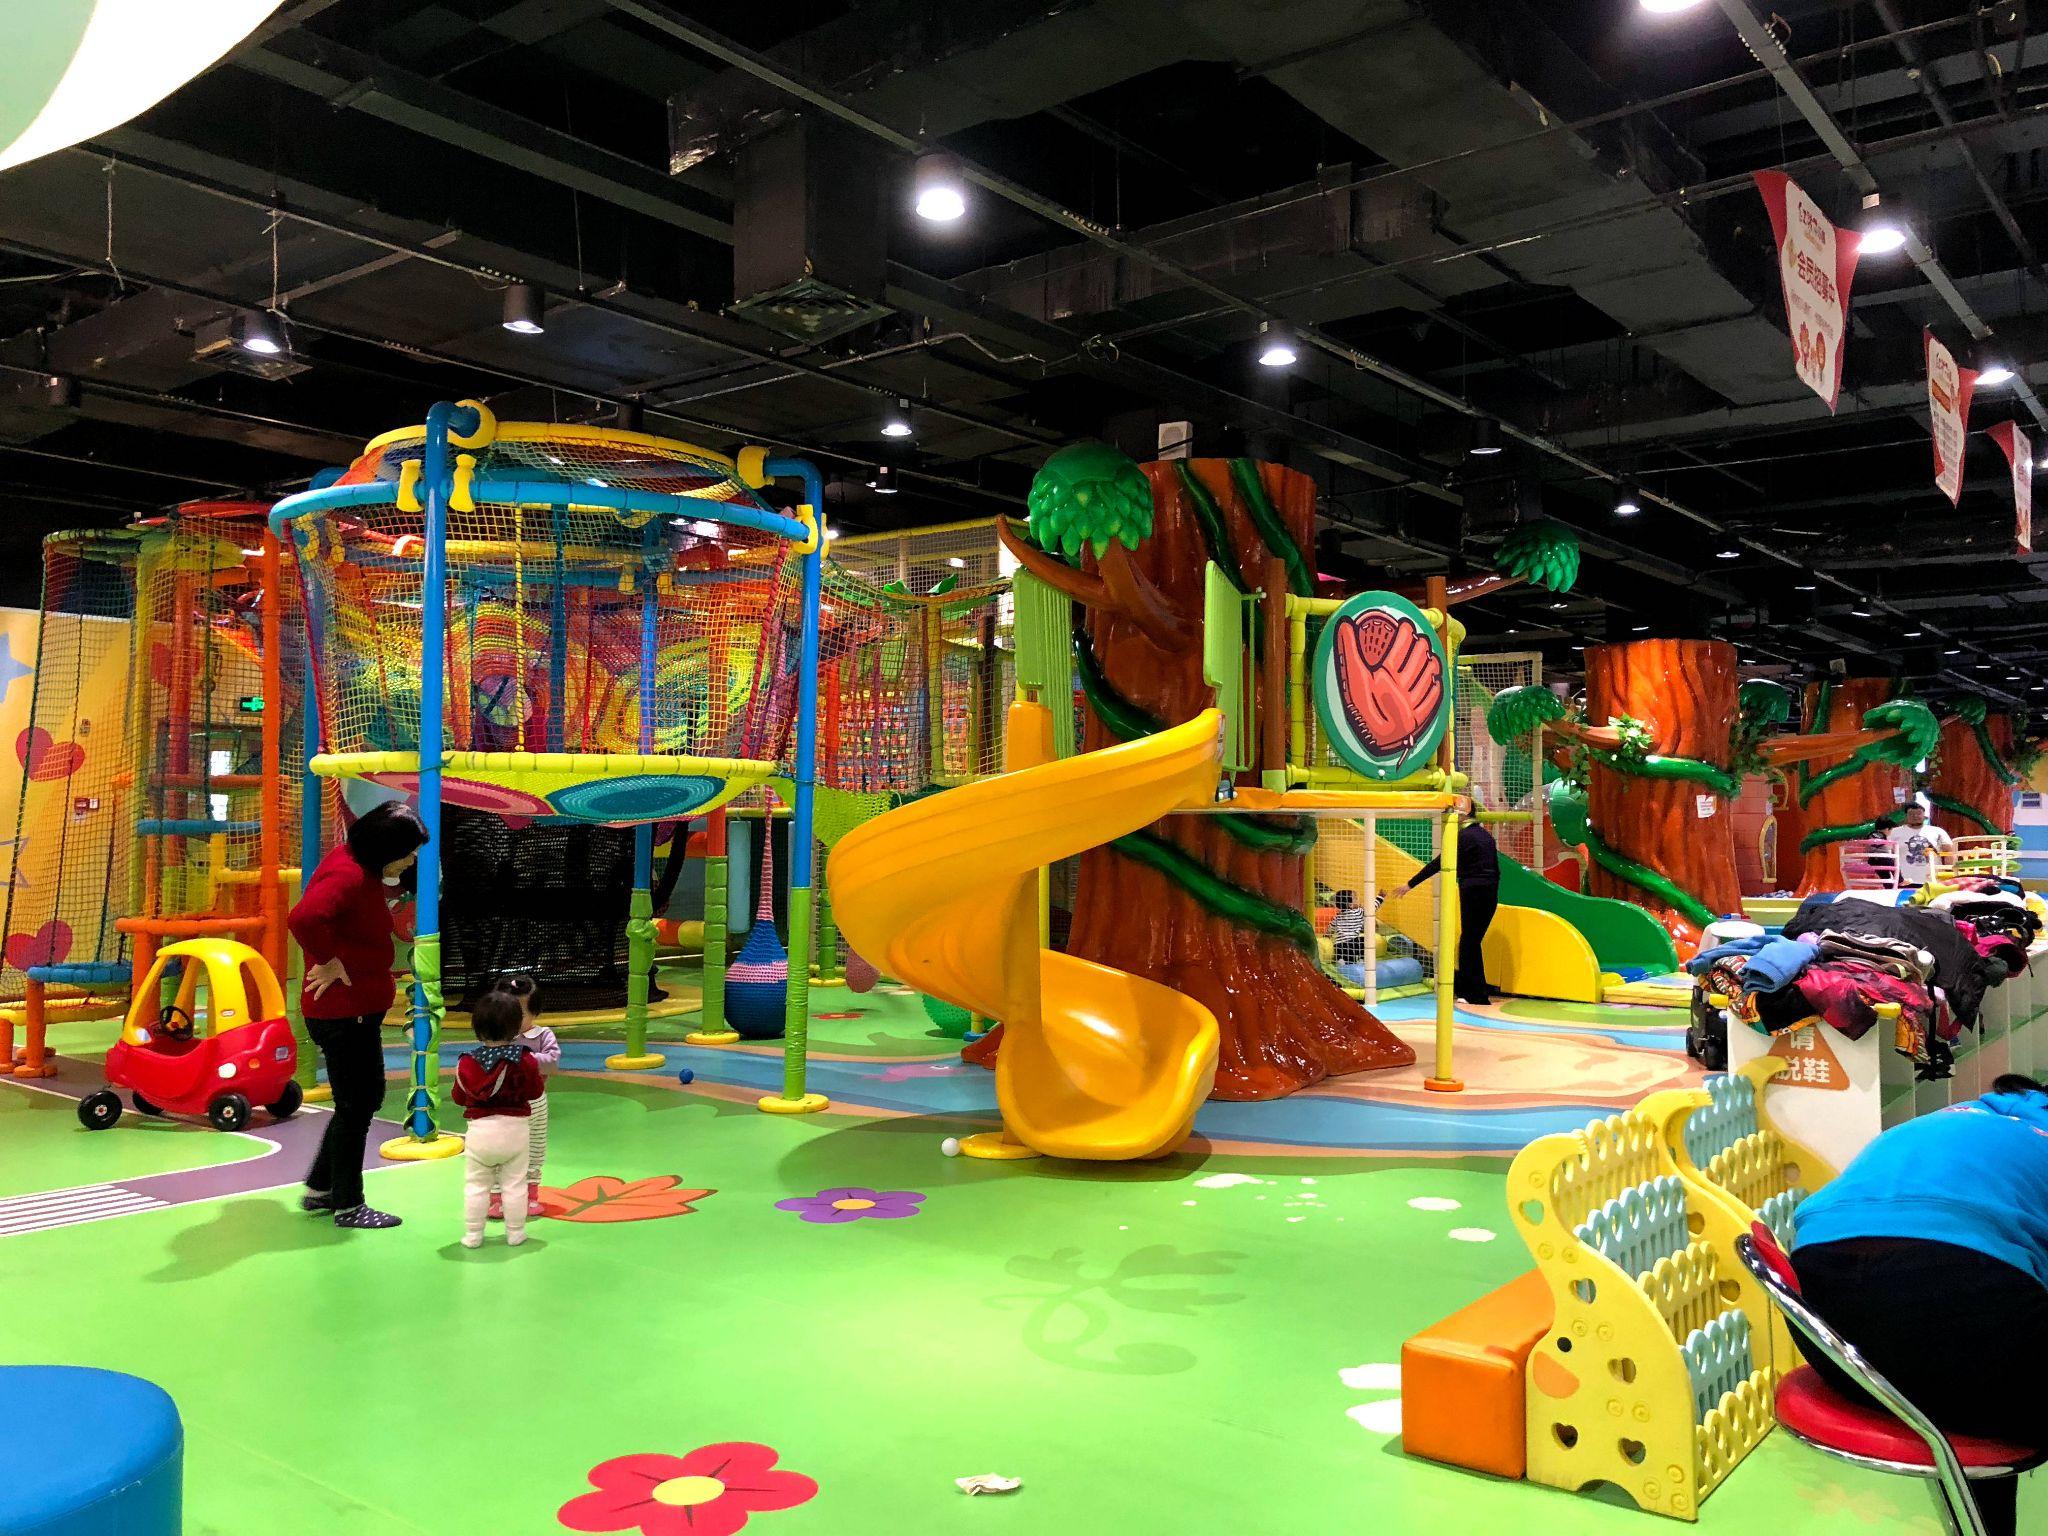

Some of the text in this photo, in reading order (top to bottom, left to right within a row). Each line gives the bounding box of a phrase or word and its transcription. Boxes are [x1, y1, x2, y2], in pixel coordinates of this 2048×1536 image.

[1797, 250, 1836, 308] 会员招募中
